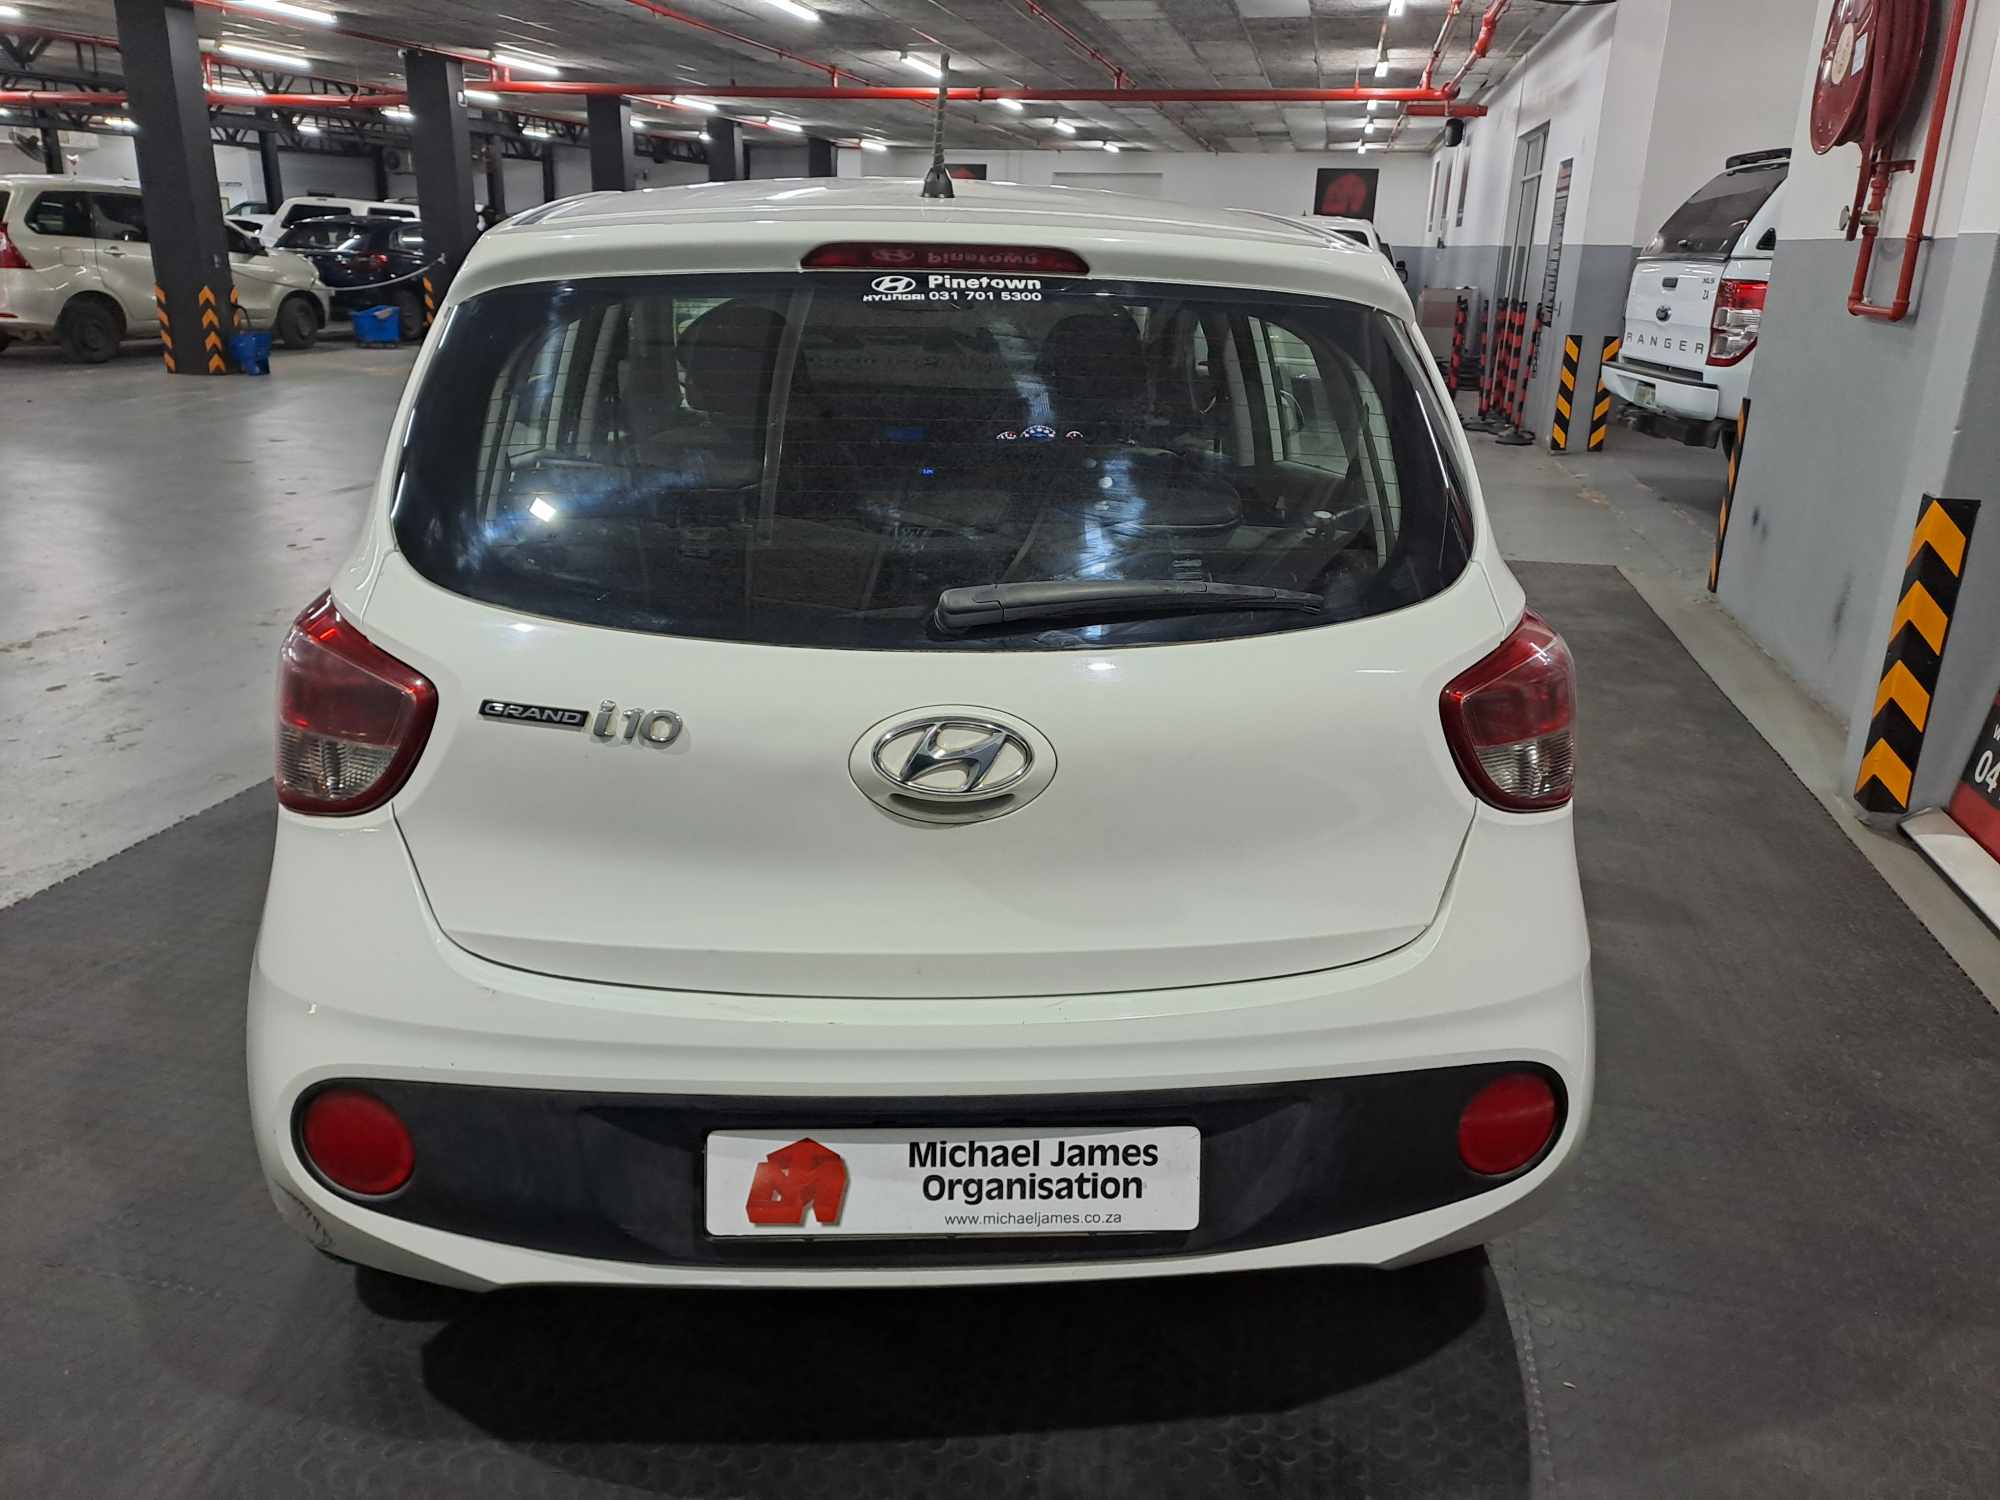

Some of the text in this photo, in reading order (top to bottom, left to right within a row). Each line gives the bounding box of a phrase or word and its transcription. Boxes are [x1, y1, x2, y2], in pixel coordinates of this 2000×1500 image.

[928, 275, 1042, 290] Pinetown
[863, 293, 925, 302] HYUNDAI
[929, 291, 1042, 301] 031 701 5300
[1626, 332, 1704, 354] RANGER
[484, 700, 683, 743] GRAND i10
[909, 1140, 1159, 1168] Michael James
[923, 1173, 1143, 1206] Organisation
[945, 1212, 1122, 1227] www.michaeljames.co.za
